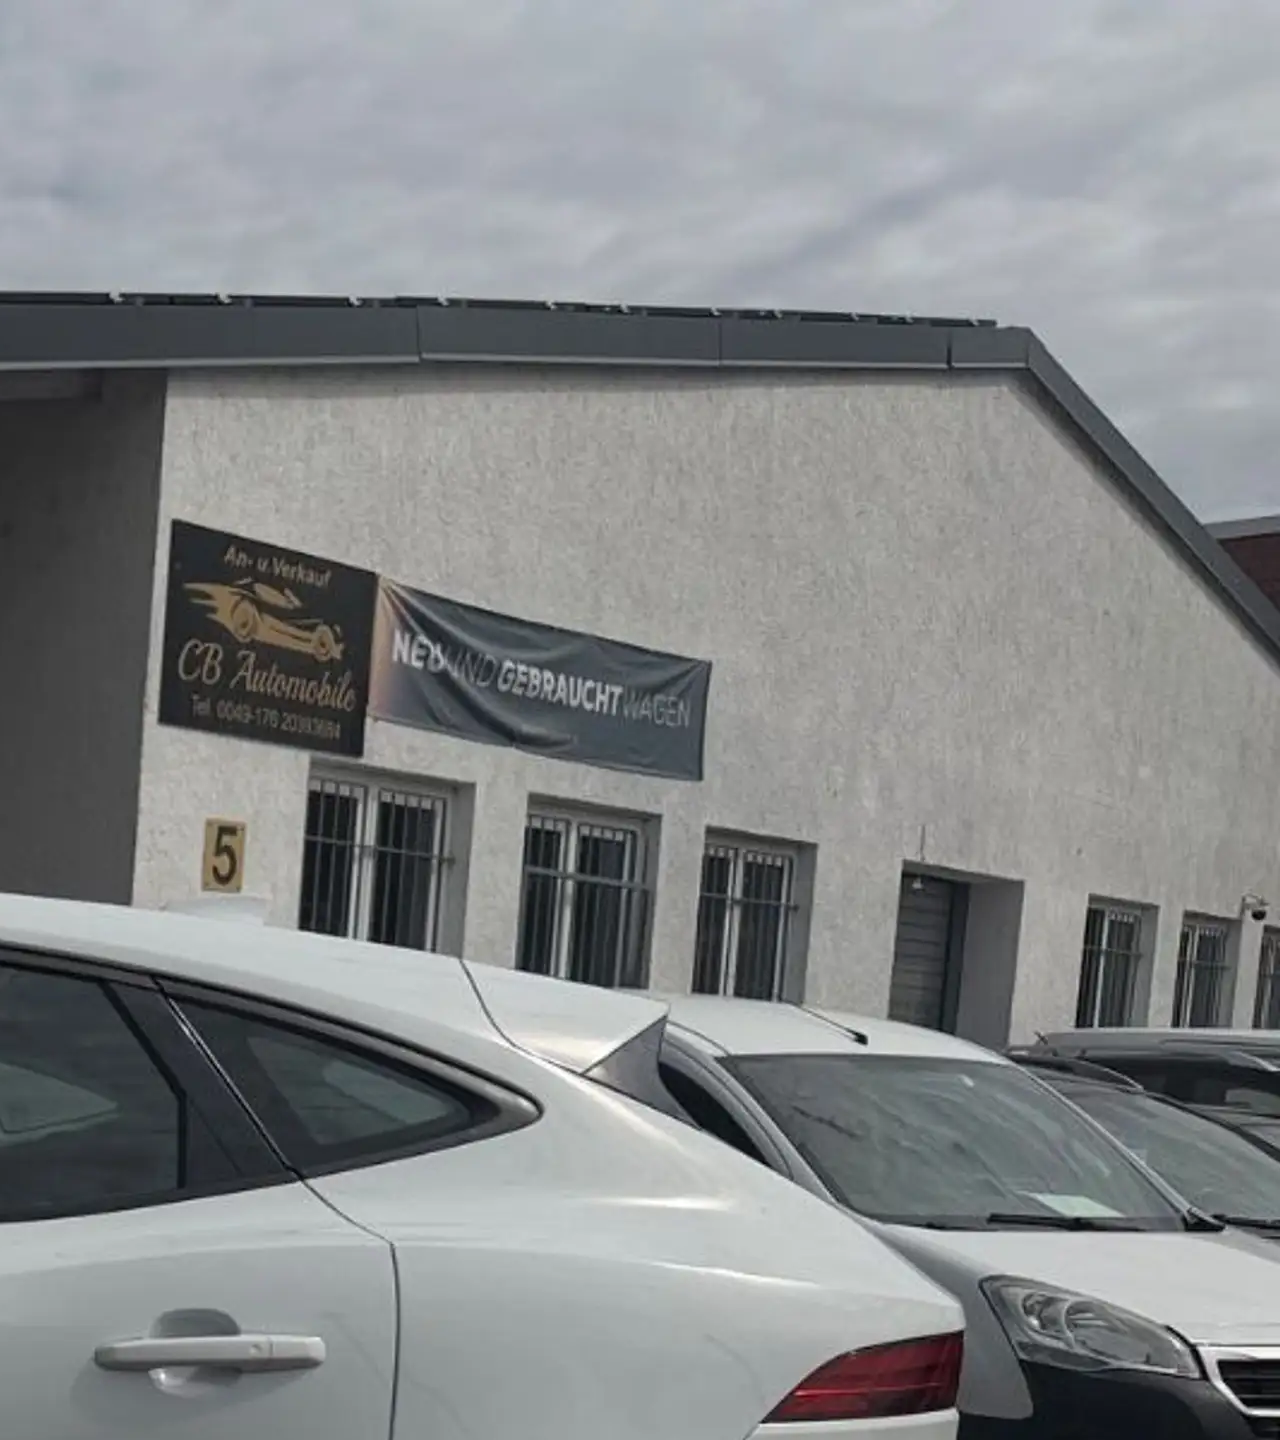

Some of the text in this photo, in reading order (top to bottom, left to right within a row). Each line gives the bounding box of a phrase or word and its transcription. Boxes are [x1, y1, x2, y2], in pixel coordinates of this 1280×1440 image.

[177, 638, 357, 712] CB Automobile
[211, 825, 238, 887] 5
